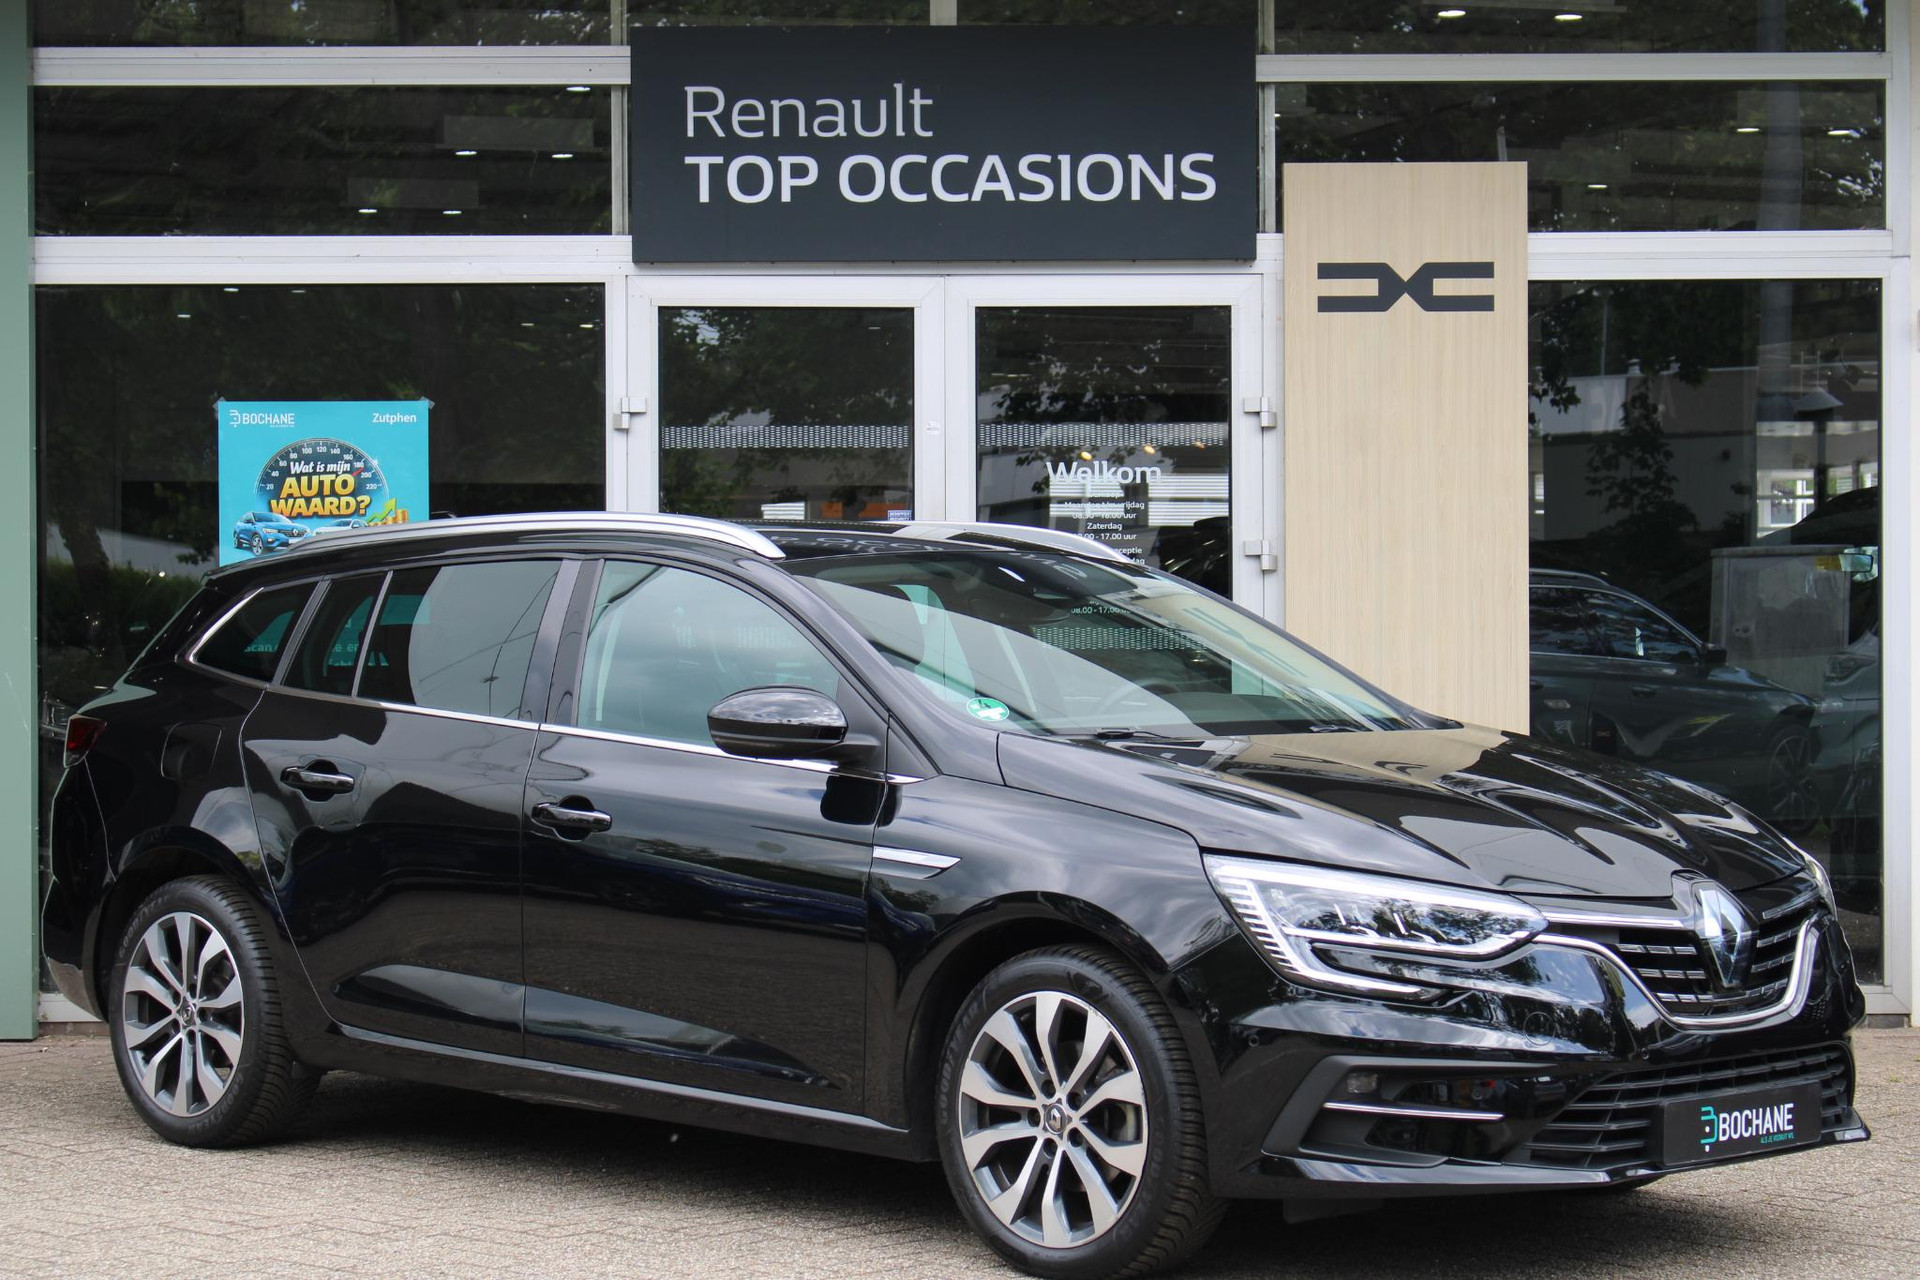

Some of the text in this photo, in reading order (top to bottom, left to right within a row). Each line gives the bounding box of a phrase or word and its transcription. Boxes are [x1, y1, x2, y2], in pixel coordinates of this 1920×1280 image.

[684, 83, 933, 138] Renault
[684, 153, 1217, 203] TOP OCCASIONS
[242, 413, 295, 424] BOCHANE
[372, 412, 417, 424] Zutphen
[301, 447, 313, 455] 100
[343, 453, 354, 461] 160
[290, 460, 350, 474] Wat is mijn
[1046, 461, 1161, 484] Welkom
[280, 473, 355, 498] AUTO
[270, 495, 371, 517] WAARD?
[1087, 522, 1122, 531] Zaterdag
[1719, 1103, 1794, 1141] BOCHANE
